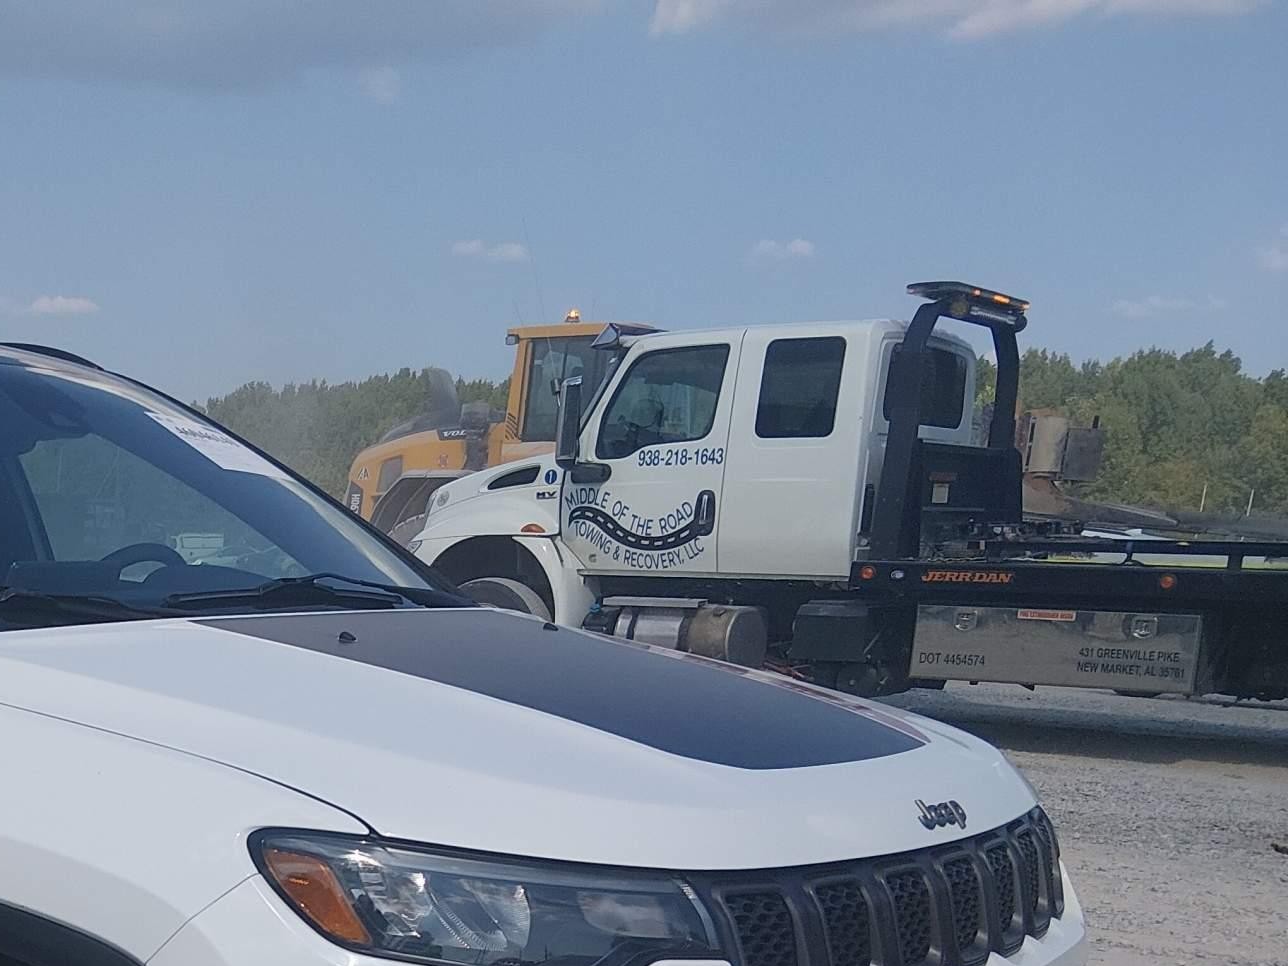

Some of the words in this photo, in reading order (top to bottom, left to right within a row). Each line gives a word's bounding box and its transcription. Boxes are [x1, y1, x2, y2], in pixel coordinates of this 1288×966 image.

[638, 448, 724, 466] 938-218-1643
[564, 487, 610, 511] MIDDLE
[612, 500, 629, 521] OF
[628, 514, 653, 536] THE
[659, 501, 693, 534] ROAD
[573, 520, 612, 555] TOWING
[612, 546, 620, 561] &
[624, 549, 685, 570] RECOVERY,
[688, 537, 705, 559] LLC
[919, 652, 941, 664] DOT
[943, 654, 985, 666] 4454574
[1078, 648, 1094, 657] 431
[1096, 648, 1156, 661] GREENVILLE
[1157, 651, 1180, 662] PIKE
[1076, 662, 1099, 673] NEW
[1100, 663, 1142, 677] MARKET,
[1143, 666, 1157, 677] AL
[914, 799, 966, 830] Jeep
